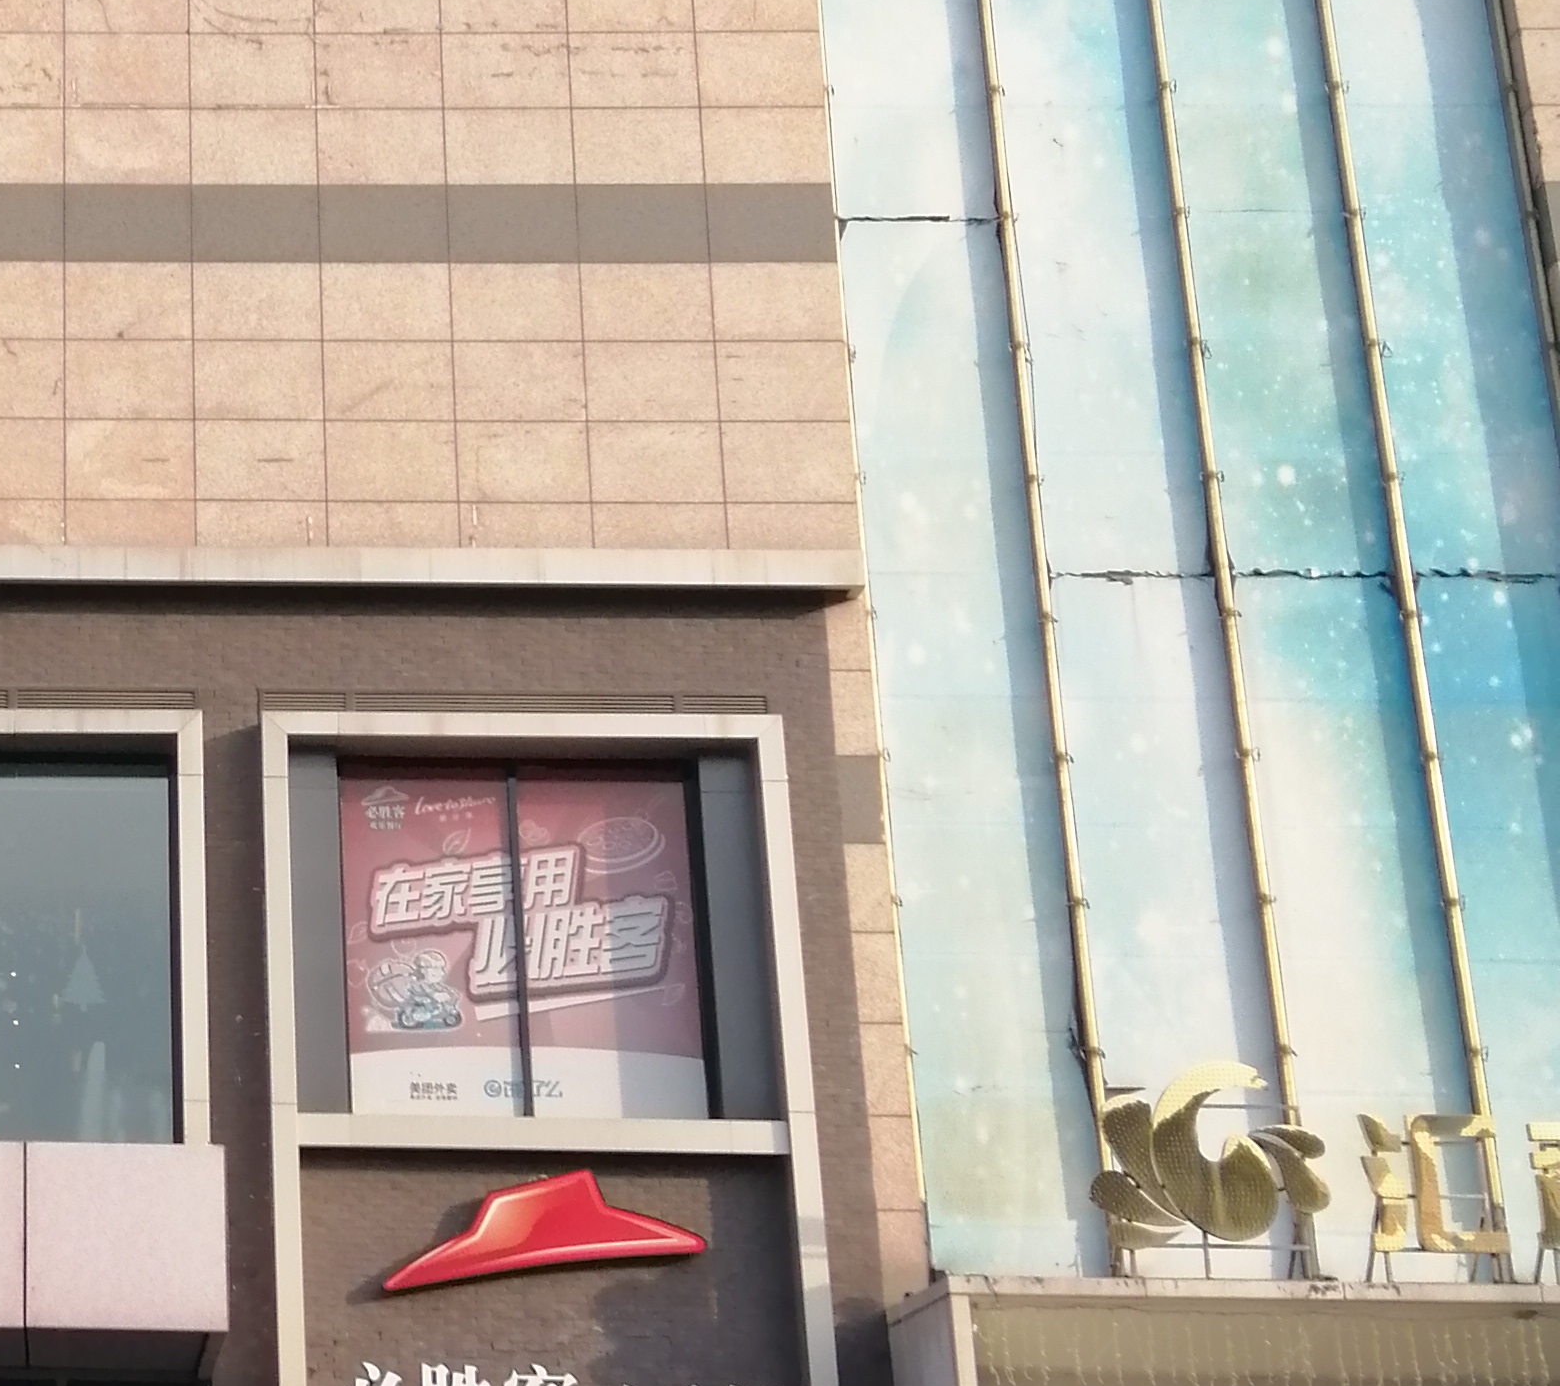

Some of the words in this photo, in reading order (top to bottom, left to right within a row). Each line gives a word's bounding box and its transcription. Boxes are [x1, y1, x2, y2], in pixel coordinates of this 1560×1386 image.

[375, 850, 575, 926] 在家享用
[474, 899, 663, 987] 必胜客
